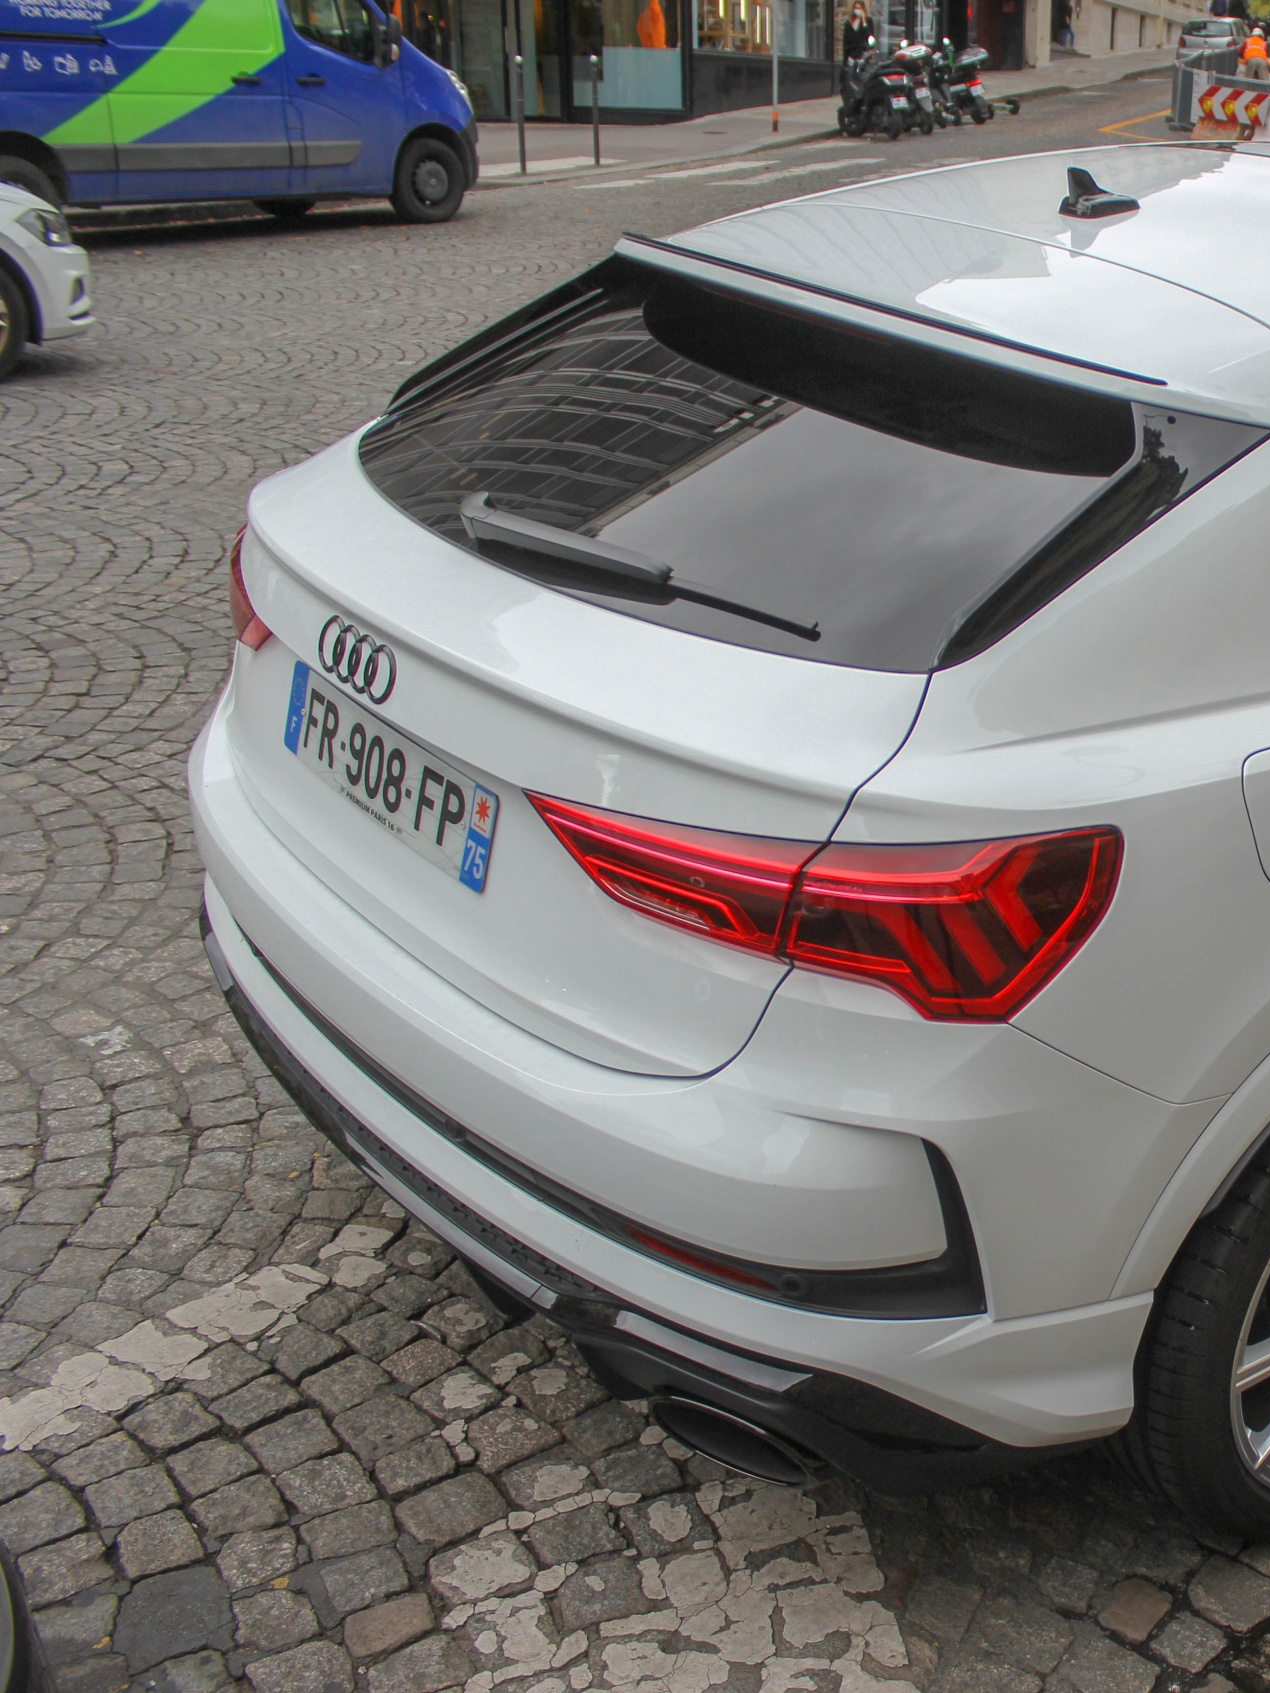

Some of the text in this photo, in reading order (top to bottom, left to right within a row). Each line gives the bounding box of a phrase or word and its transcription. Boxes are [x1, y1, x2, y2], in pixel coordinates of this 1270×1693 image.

[20, 5, 103, 21] FOR TOMORROW
[290, 715, 298, 732] F
[303, 687, 466, 847] FR-908-FP
[345, 791, 395, 831] PREMIUM PARIS 16
[464, 838, 486, 879] 75
